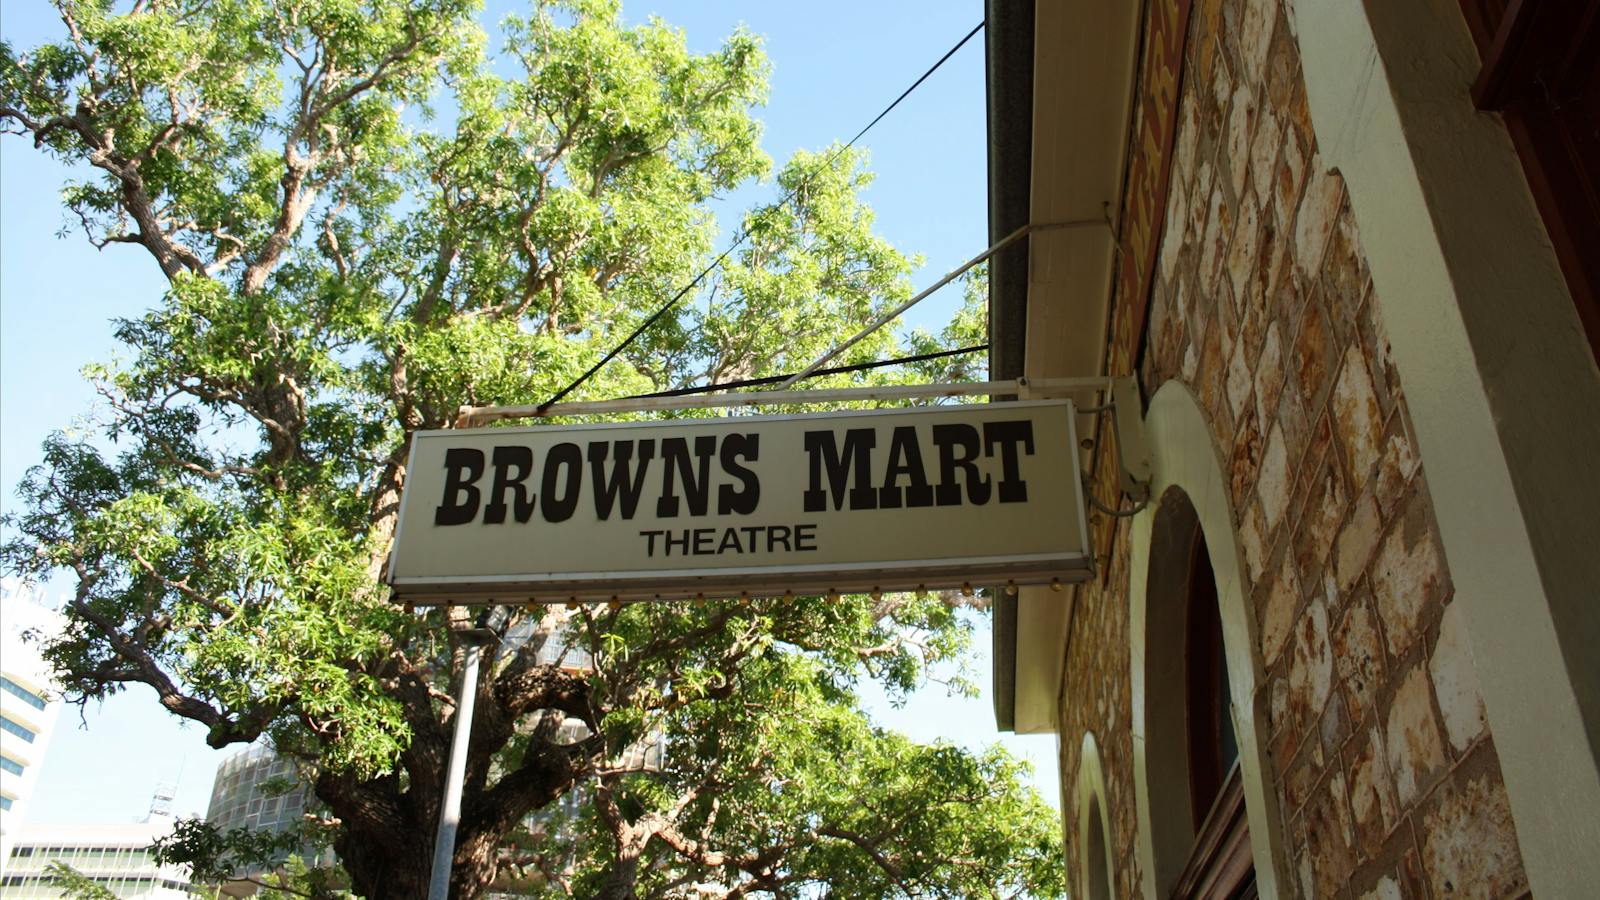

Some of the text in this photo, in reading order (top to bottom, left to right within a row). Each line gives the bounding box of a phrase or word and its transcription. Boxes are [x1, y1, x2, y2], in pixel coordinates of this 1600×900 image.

[434, 420, 1036, 527] BROWNS MART
[640, 524, 818, 557] THEATRE
